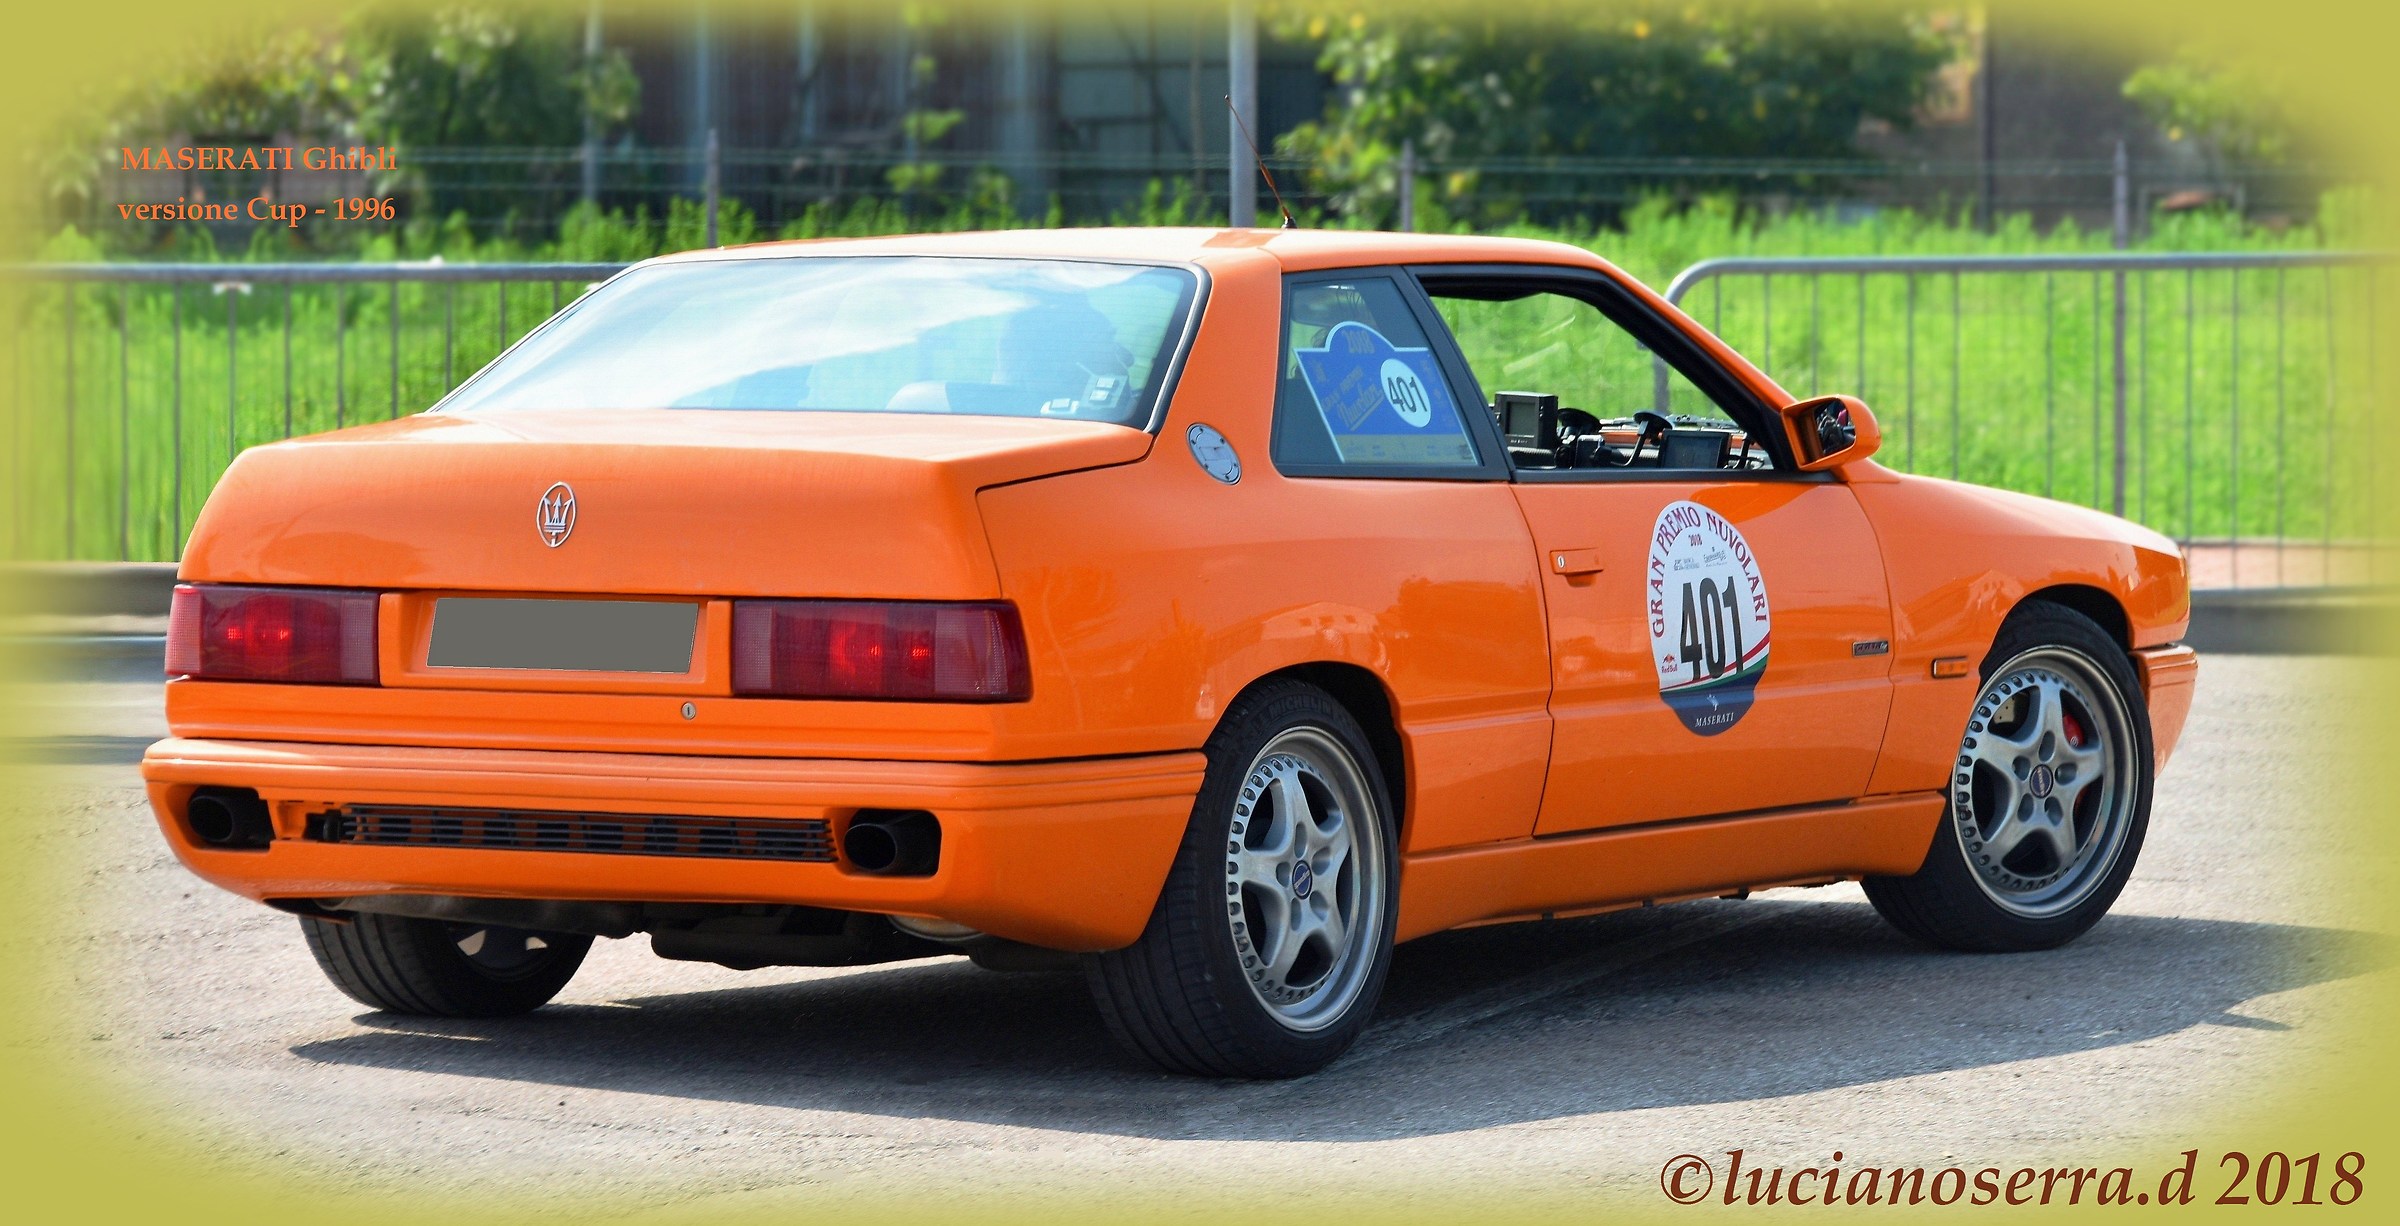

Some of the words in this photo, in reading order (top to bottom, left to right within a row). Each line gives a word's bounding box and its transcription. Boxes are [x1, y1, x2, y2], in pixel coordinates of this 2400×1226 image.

[1387, 376, 1428, 414] 401
[1656, 506, 1702, 556] PREMIO
[1650, 554, 1666, 638] GRAN
[1705, 511, 1768, 622] NUVOLARI
[1680, 576, 1744, 682] 401
[1695, 712, 1735, 728] MASERATI
